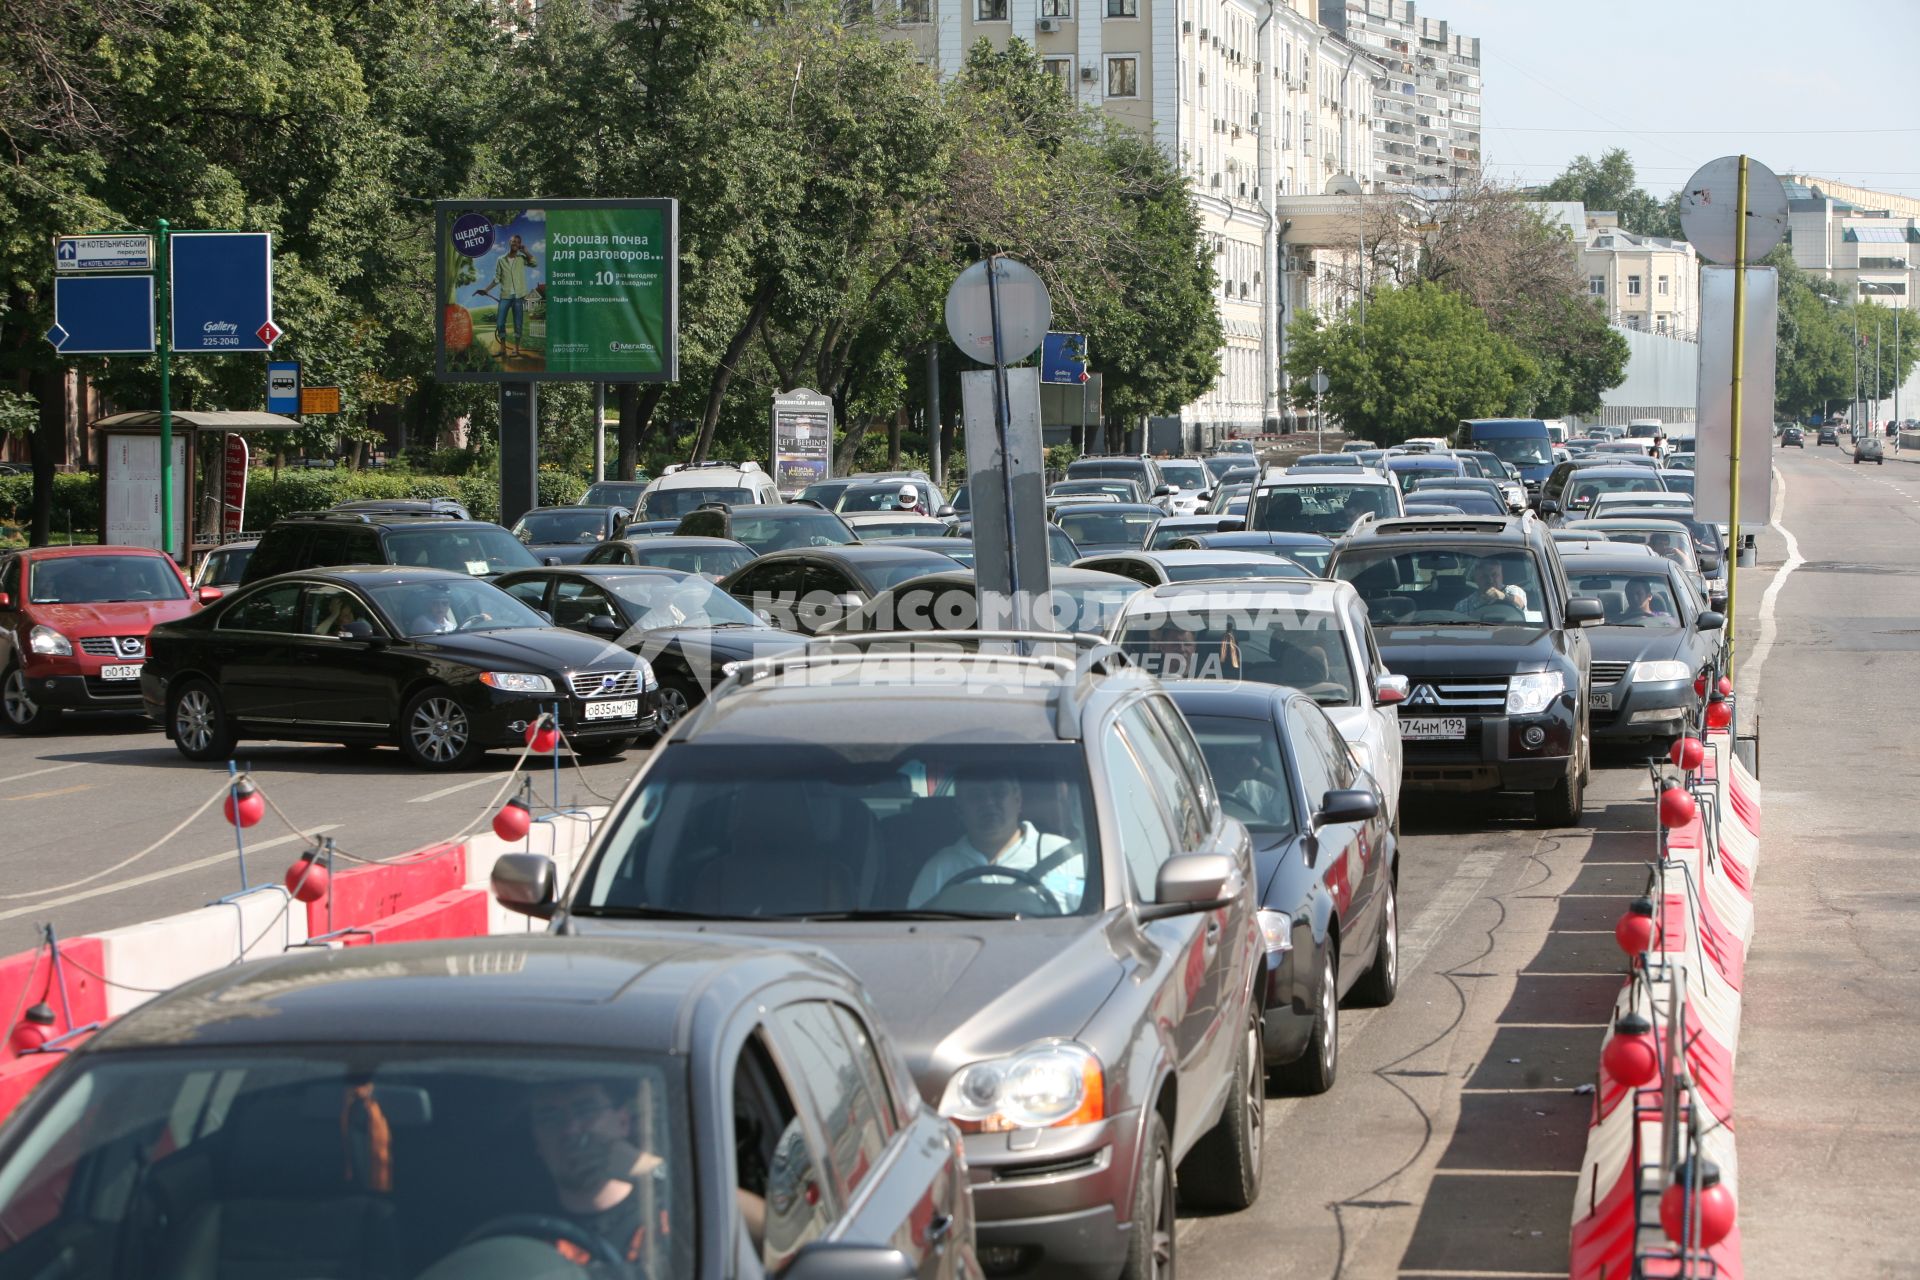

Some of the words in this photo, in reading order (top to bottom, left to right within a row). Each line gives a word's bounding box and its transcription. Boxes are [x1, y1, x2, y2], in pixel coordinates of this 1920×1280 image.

[455, 224, 490, 241] ЩЕДРОЕ
[87, 239, 147, 249] КОТЕЛЬНИЧЕСКИЙ
[464, 236, 485, 249] ЛЕТО
[553, 232, 609, 247] Хорошая
[612, 235, 649, 245] почва
[552, 250, 576, 261] для
[579, 250, 664, 262] разговоров...
[595, 271, 614, 286] 10
[553, 296, 573, 304] Тариф
[203, 321, 238, 334] Gallery
[203, 337, 239, 346] 225-2040
[778, 438, 796, 446] LEFT
[797, 438, 827, 446] BEHIND
[588, 703, 622, 716] О835АМ
[624, 700, 637, 710] 197
[1441, 719, 1463, 730] 199
